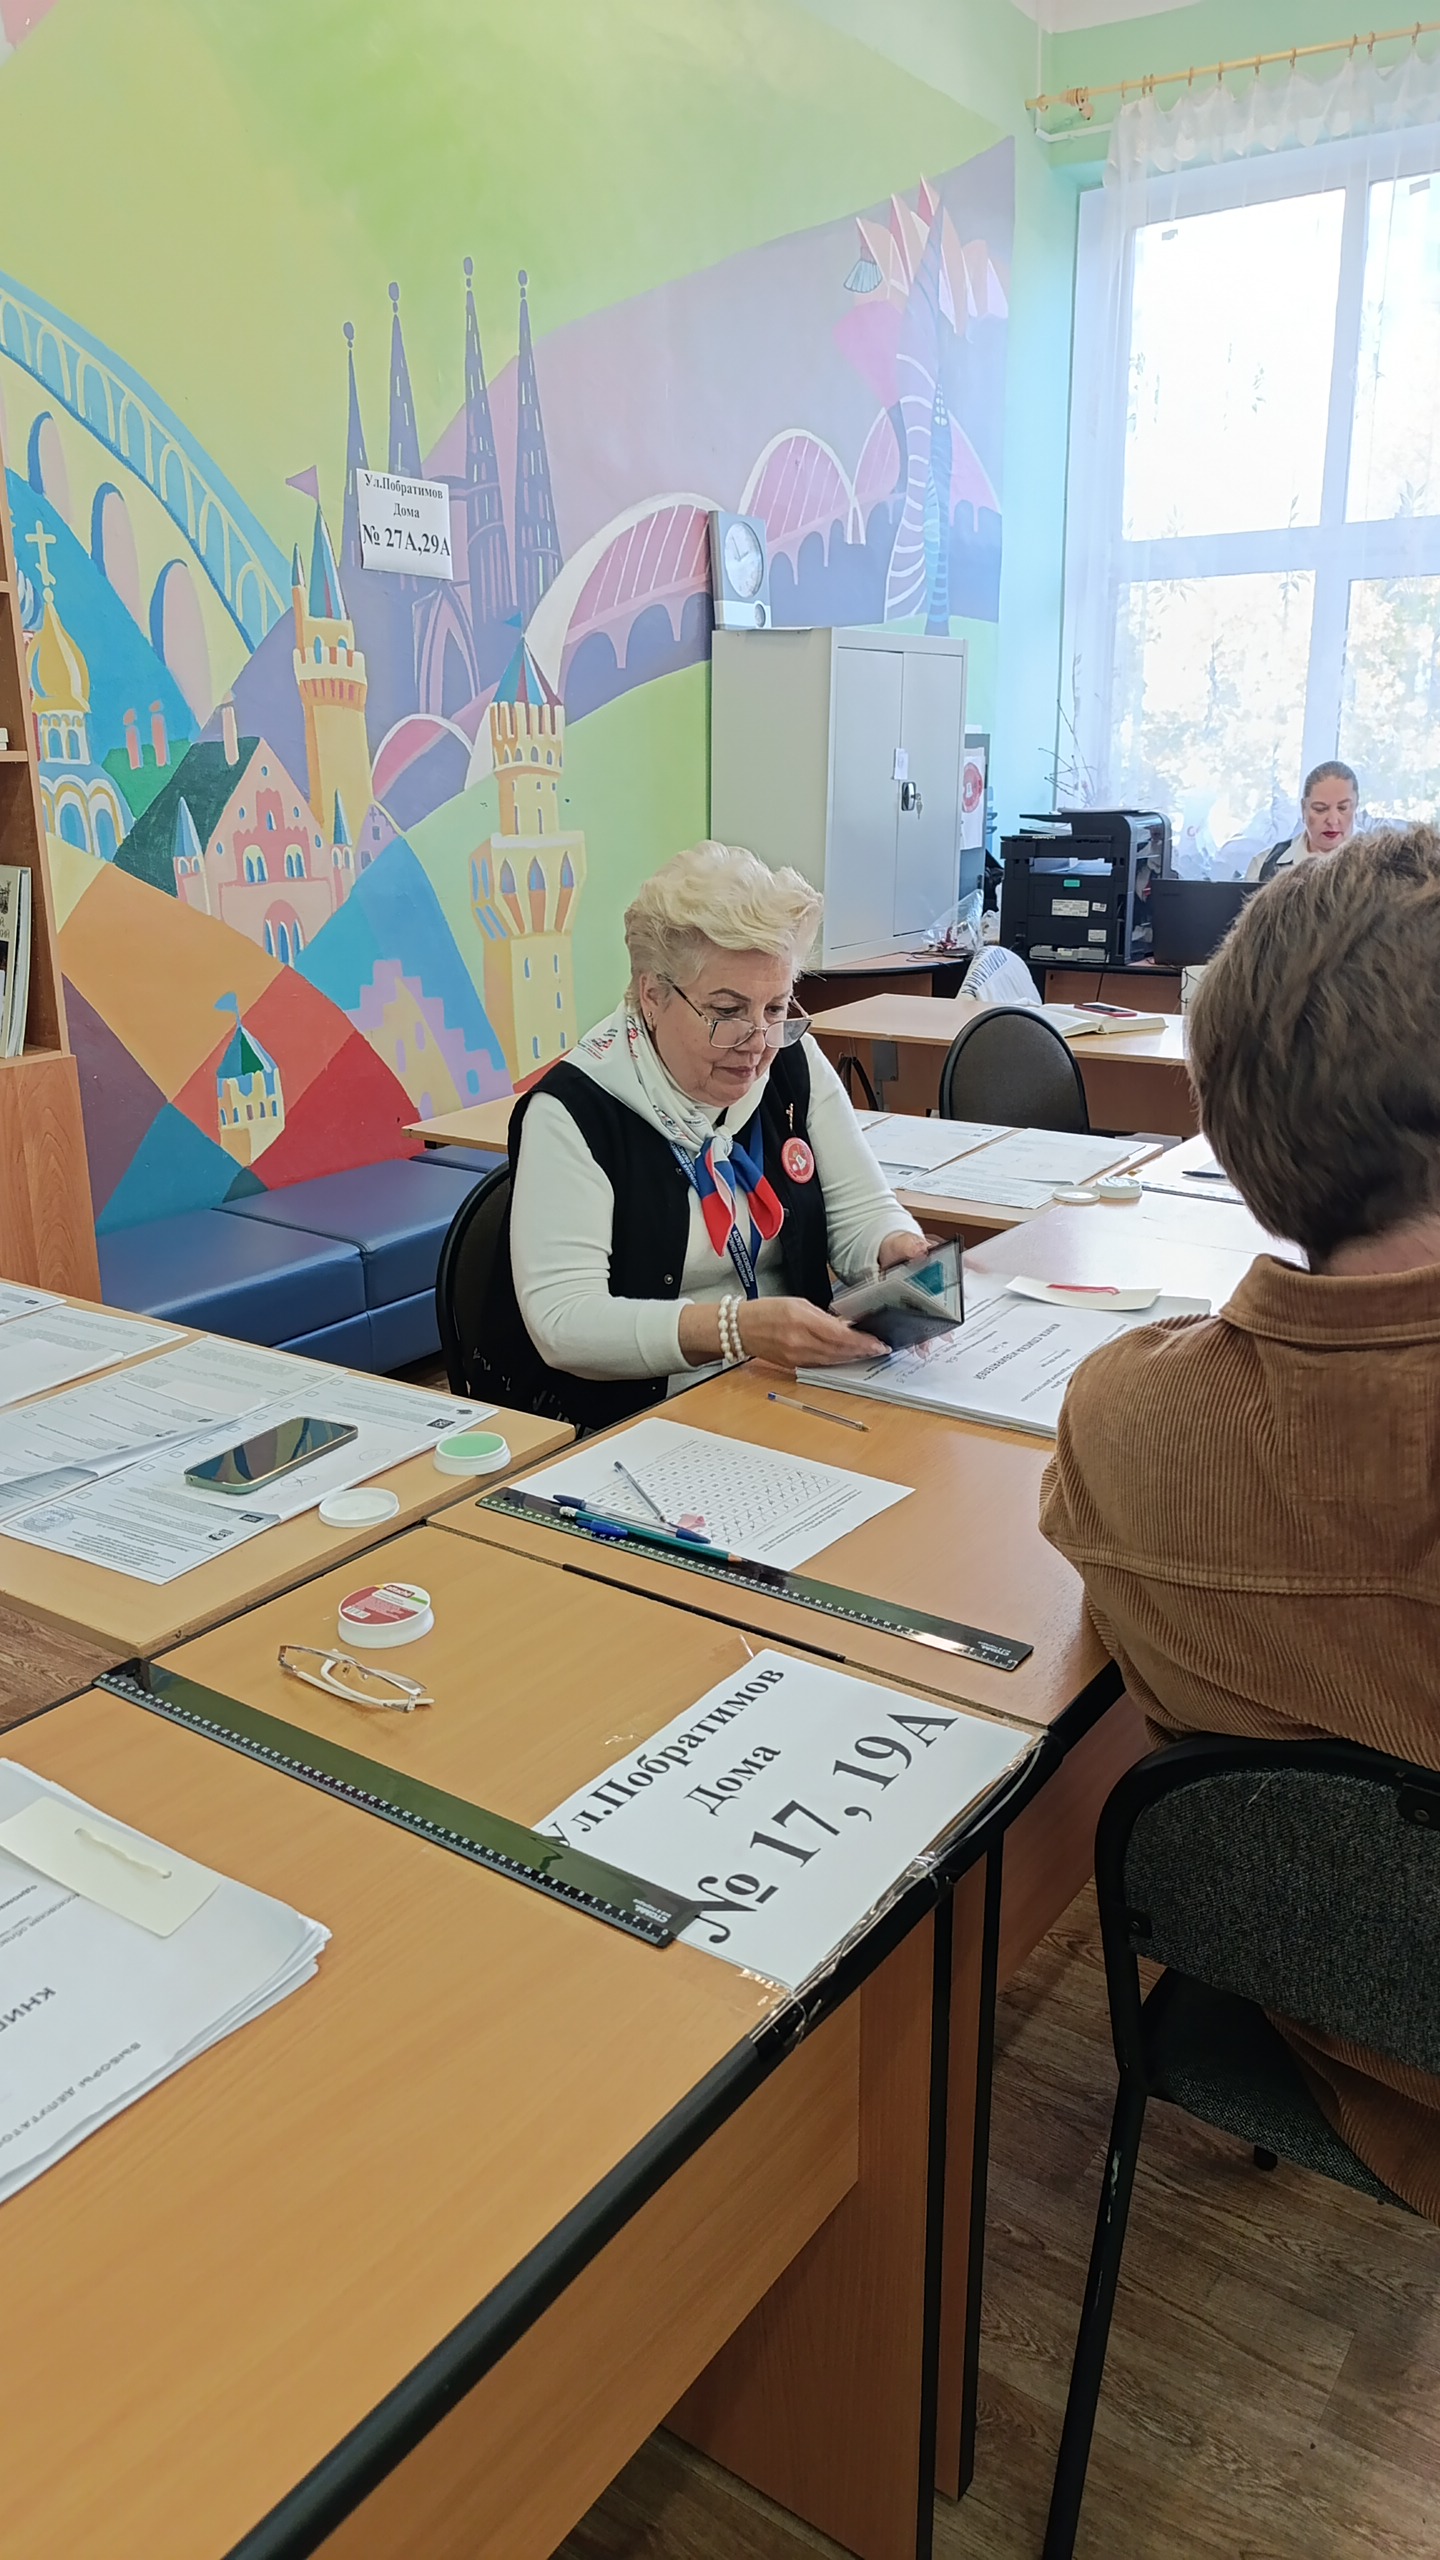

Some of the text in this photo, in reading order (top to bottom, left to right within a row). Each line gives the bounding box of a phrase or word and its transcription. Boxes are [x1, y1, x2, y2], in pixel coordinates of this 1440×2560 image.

[364, 473, 443, 499] Ул.Побратимов
[393, 503, 420, 518] Дома
[362, 524, 450, 556] № 27А,29А
[545, 1668, 785, 1849] Ул.Побратимов
[682, 1745, 782, 1817] Дома
[693, 1873, 780, 1944] №
